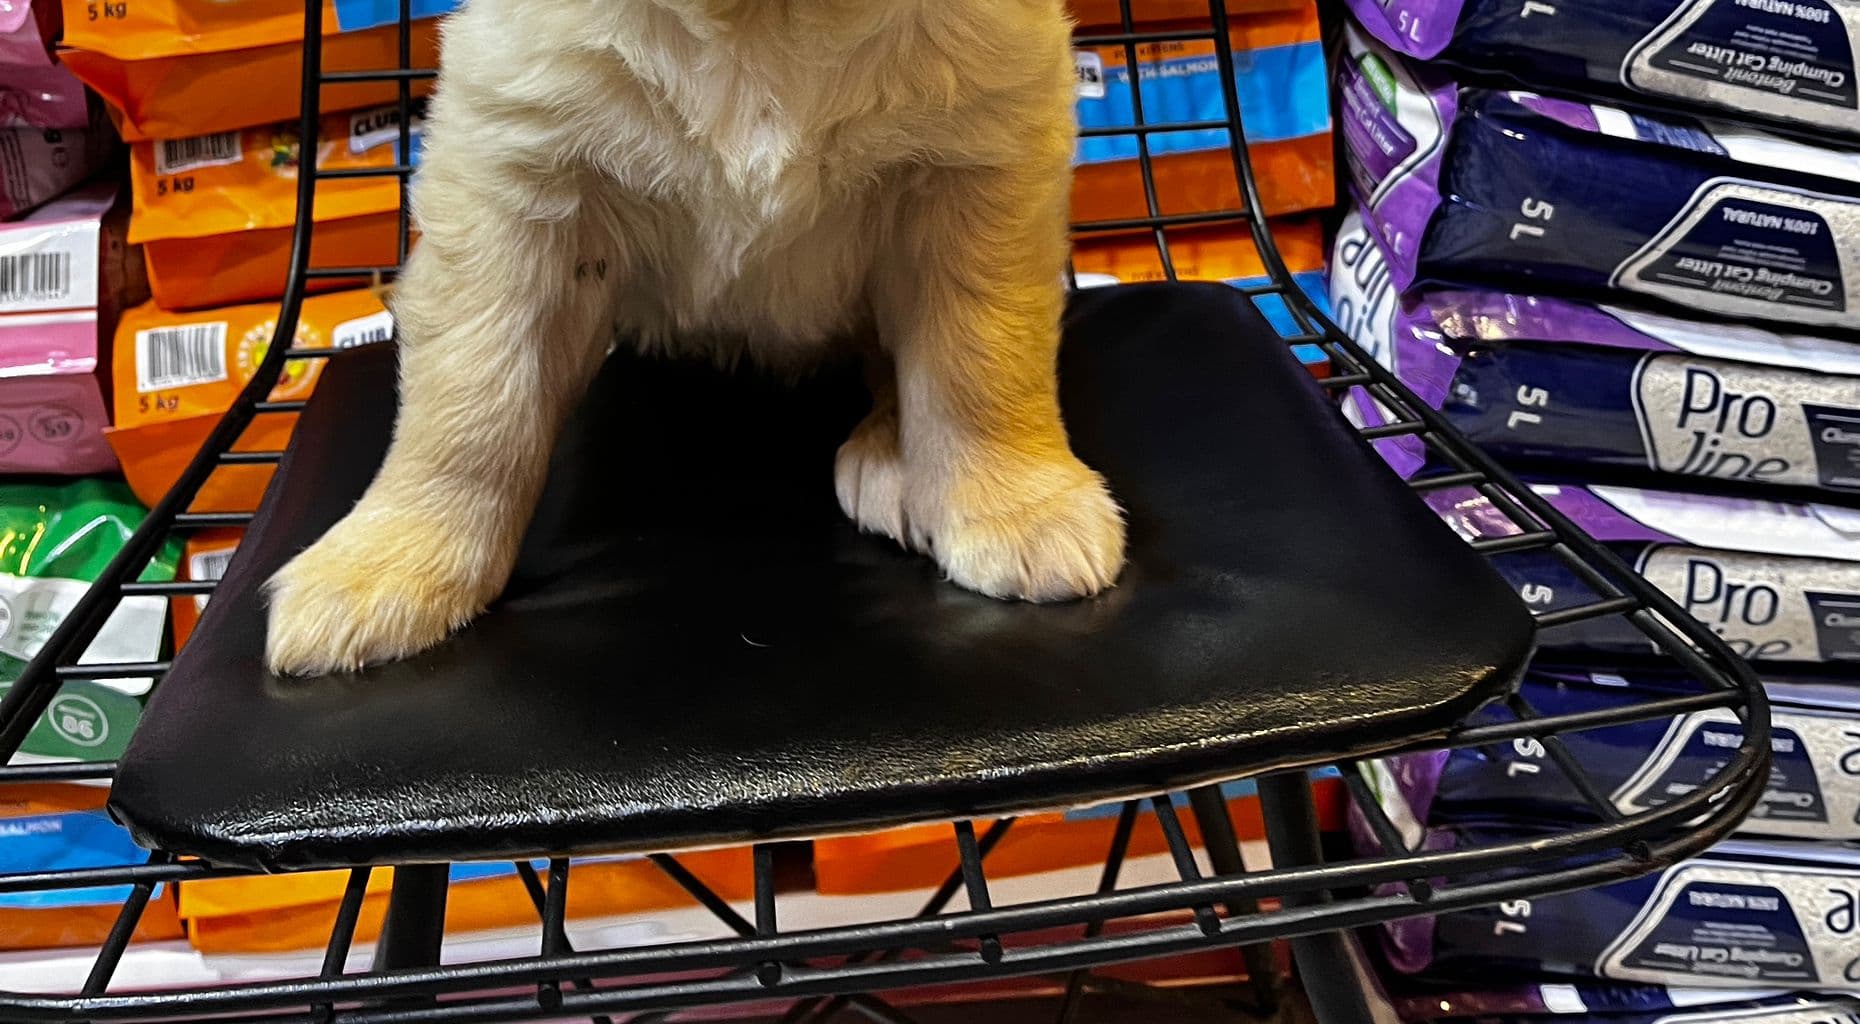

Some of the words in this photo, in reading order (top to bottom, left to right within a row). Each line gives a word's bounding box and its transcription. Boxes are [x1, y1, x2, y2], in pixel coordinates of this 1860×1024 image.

[87, 4, 99, 21] 5
[104, 1, 127, 19] kg
[1520, 0, 1557, 20] L
[1795, 4, 1830, 24] 100%
[1399, 9, 1409, 32] 5
[1410, 17, 1422, 43] L
[1687, 42, 1736, 65] Litter
[1736, 49, 1766, 71] Cat
[1117, 66, 1156, 83] WTH
[1159, 61, 1219, 77] SALMON
[1723, 66, 1797, 95] Bentonit
[1767, 56, 1845, 89] Clumping
[158, 179, 167, 195] 5
[173, 176, 195, 193] kg
[1521, 197, 1554, 222] 5
[1722, 206, 1784, 232] NATURAL
[1510, 223, 1545, 242] L
[1783, 218, 1818, 236] 100%
[1675, 257, 1723, 277] Litter
[1723, 263, 1754, 281] Cat
[1755, 267, 1833, 296] Clumping
[139, 397, 149, 413] 5
[156, 395, 179, 413] kg
[1517, 384, 1549, 407] 5
[1677, 367, 1776, 439] Pro
[1507, 411, 1542, 429] L
[1522, 582, 1554, 606] 5
[1685, 559, 1779, 626] Pro
[1508, 761, 1542, 778] L
[1494, 920, 1528, 937] L
